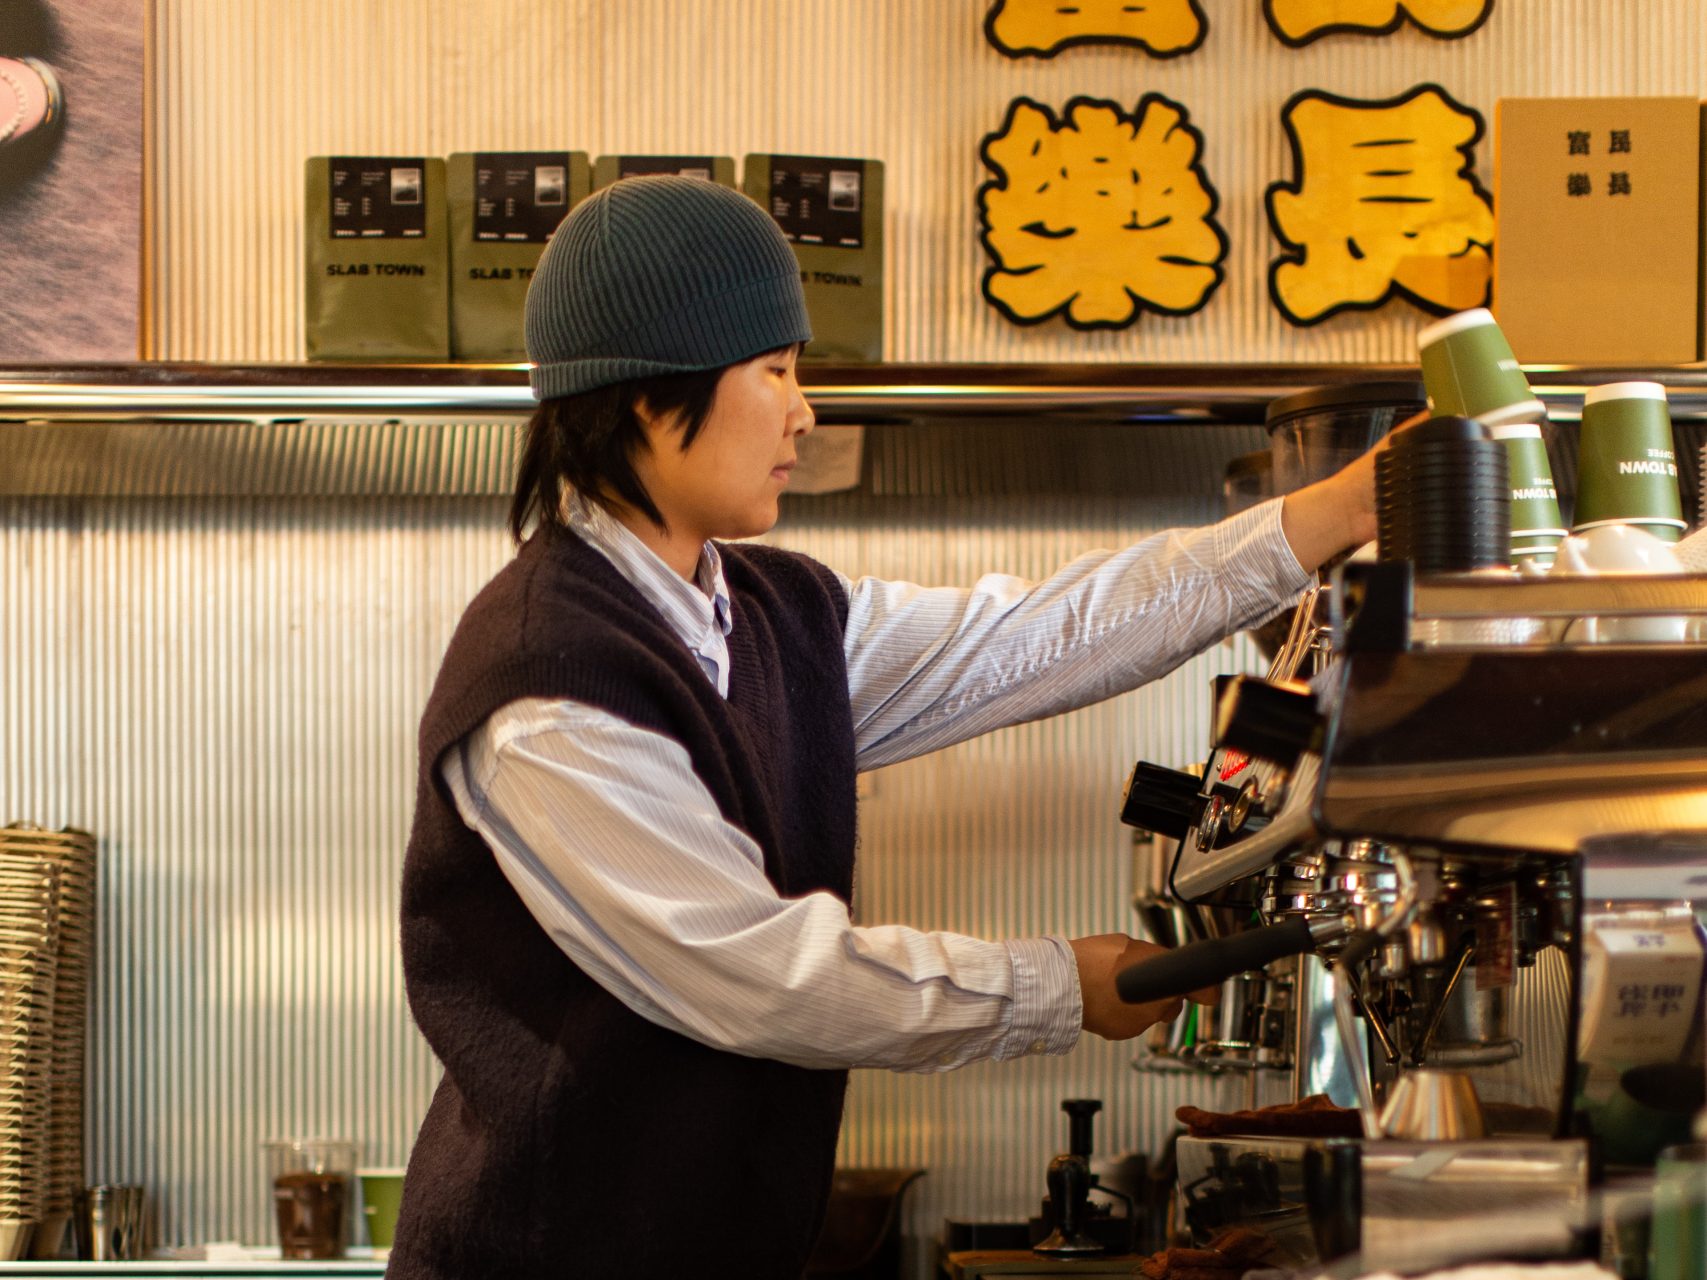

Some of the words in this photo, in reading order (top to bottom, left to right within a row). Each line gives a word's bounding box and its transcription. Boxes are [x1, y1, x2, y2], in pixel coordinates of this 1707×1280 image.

[327, 264, 369, 276] SLAB
[375, 264, 425, 277] TOWN
[469, 267, 512, 280] SLAB
[813, 272, 862, 287] TOWN
[1619, 461, 1667, 475] TOWN
[1512, 488, 1550, 500] TOWN
